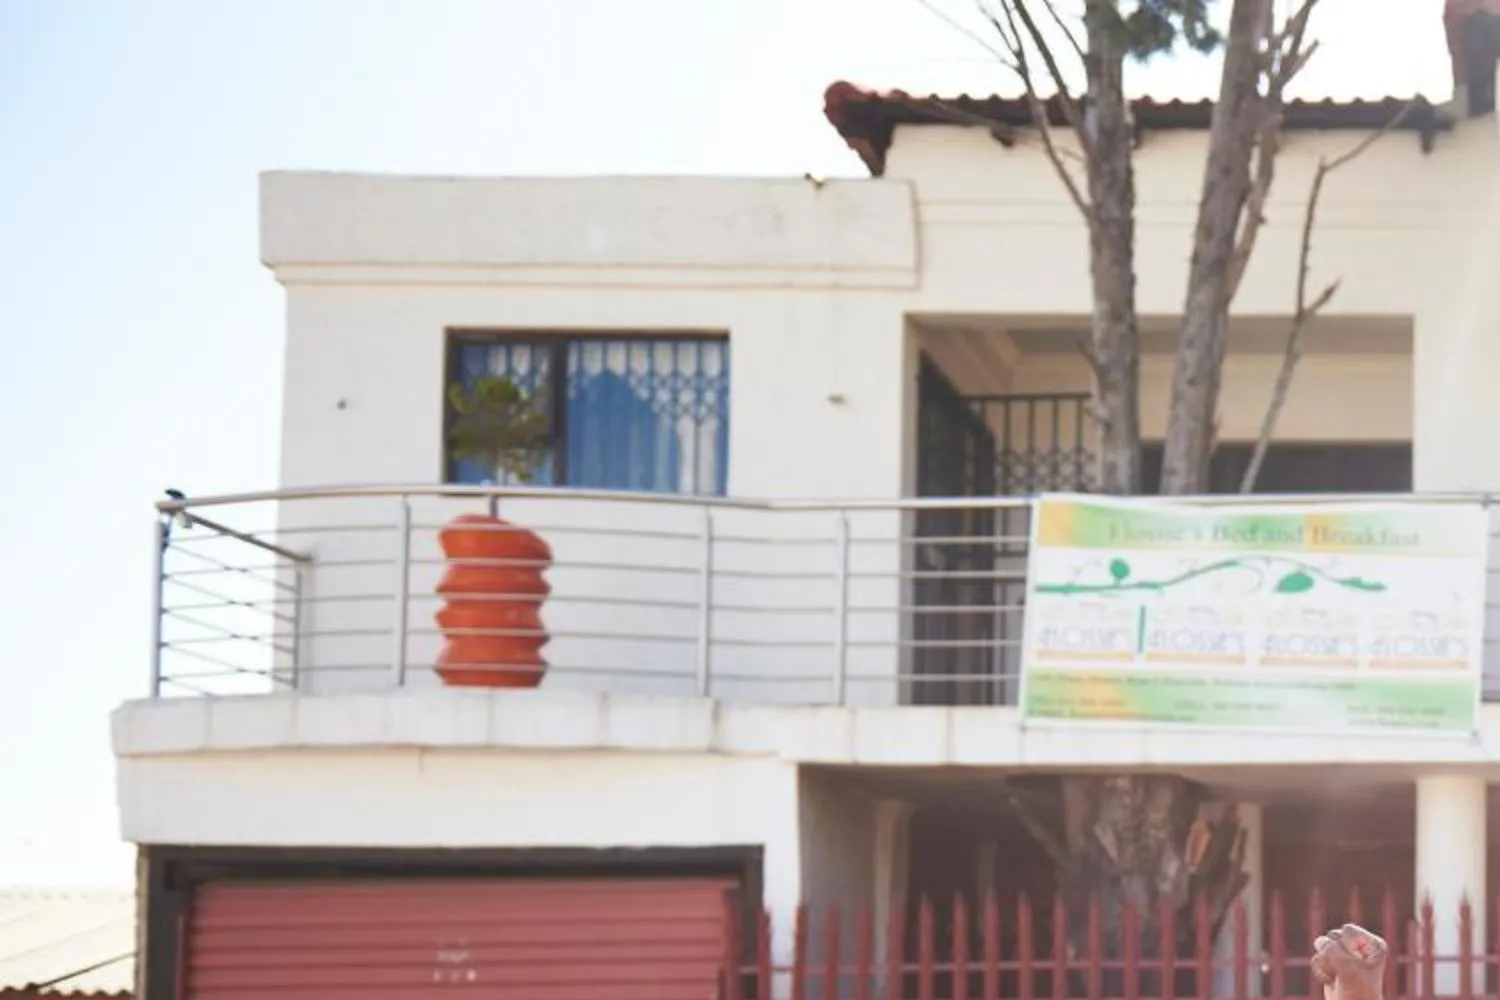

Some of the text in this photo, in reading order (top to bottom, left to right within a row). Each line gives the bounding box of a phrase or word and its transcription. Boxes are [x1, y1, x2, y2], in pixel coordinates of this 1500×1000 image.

[1211, 523, 1259, 544] Bed
[1263, 523, 1304, 544] and
[1310, 525, 1420, 547] Breakfast
